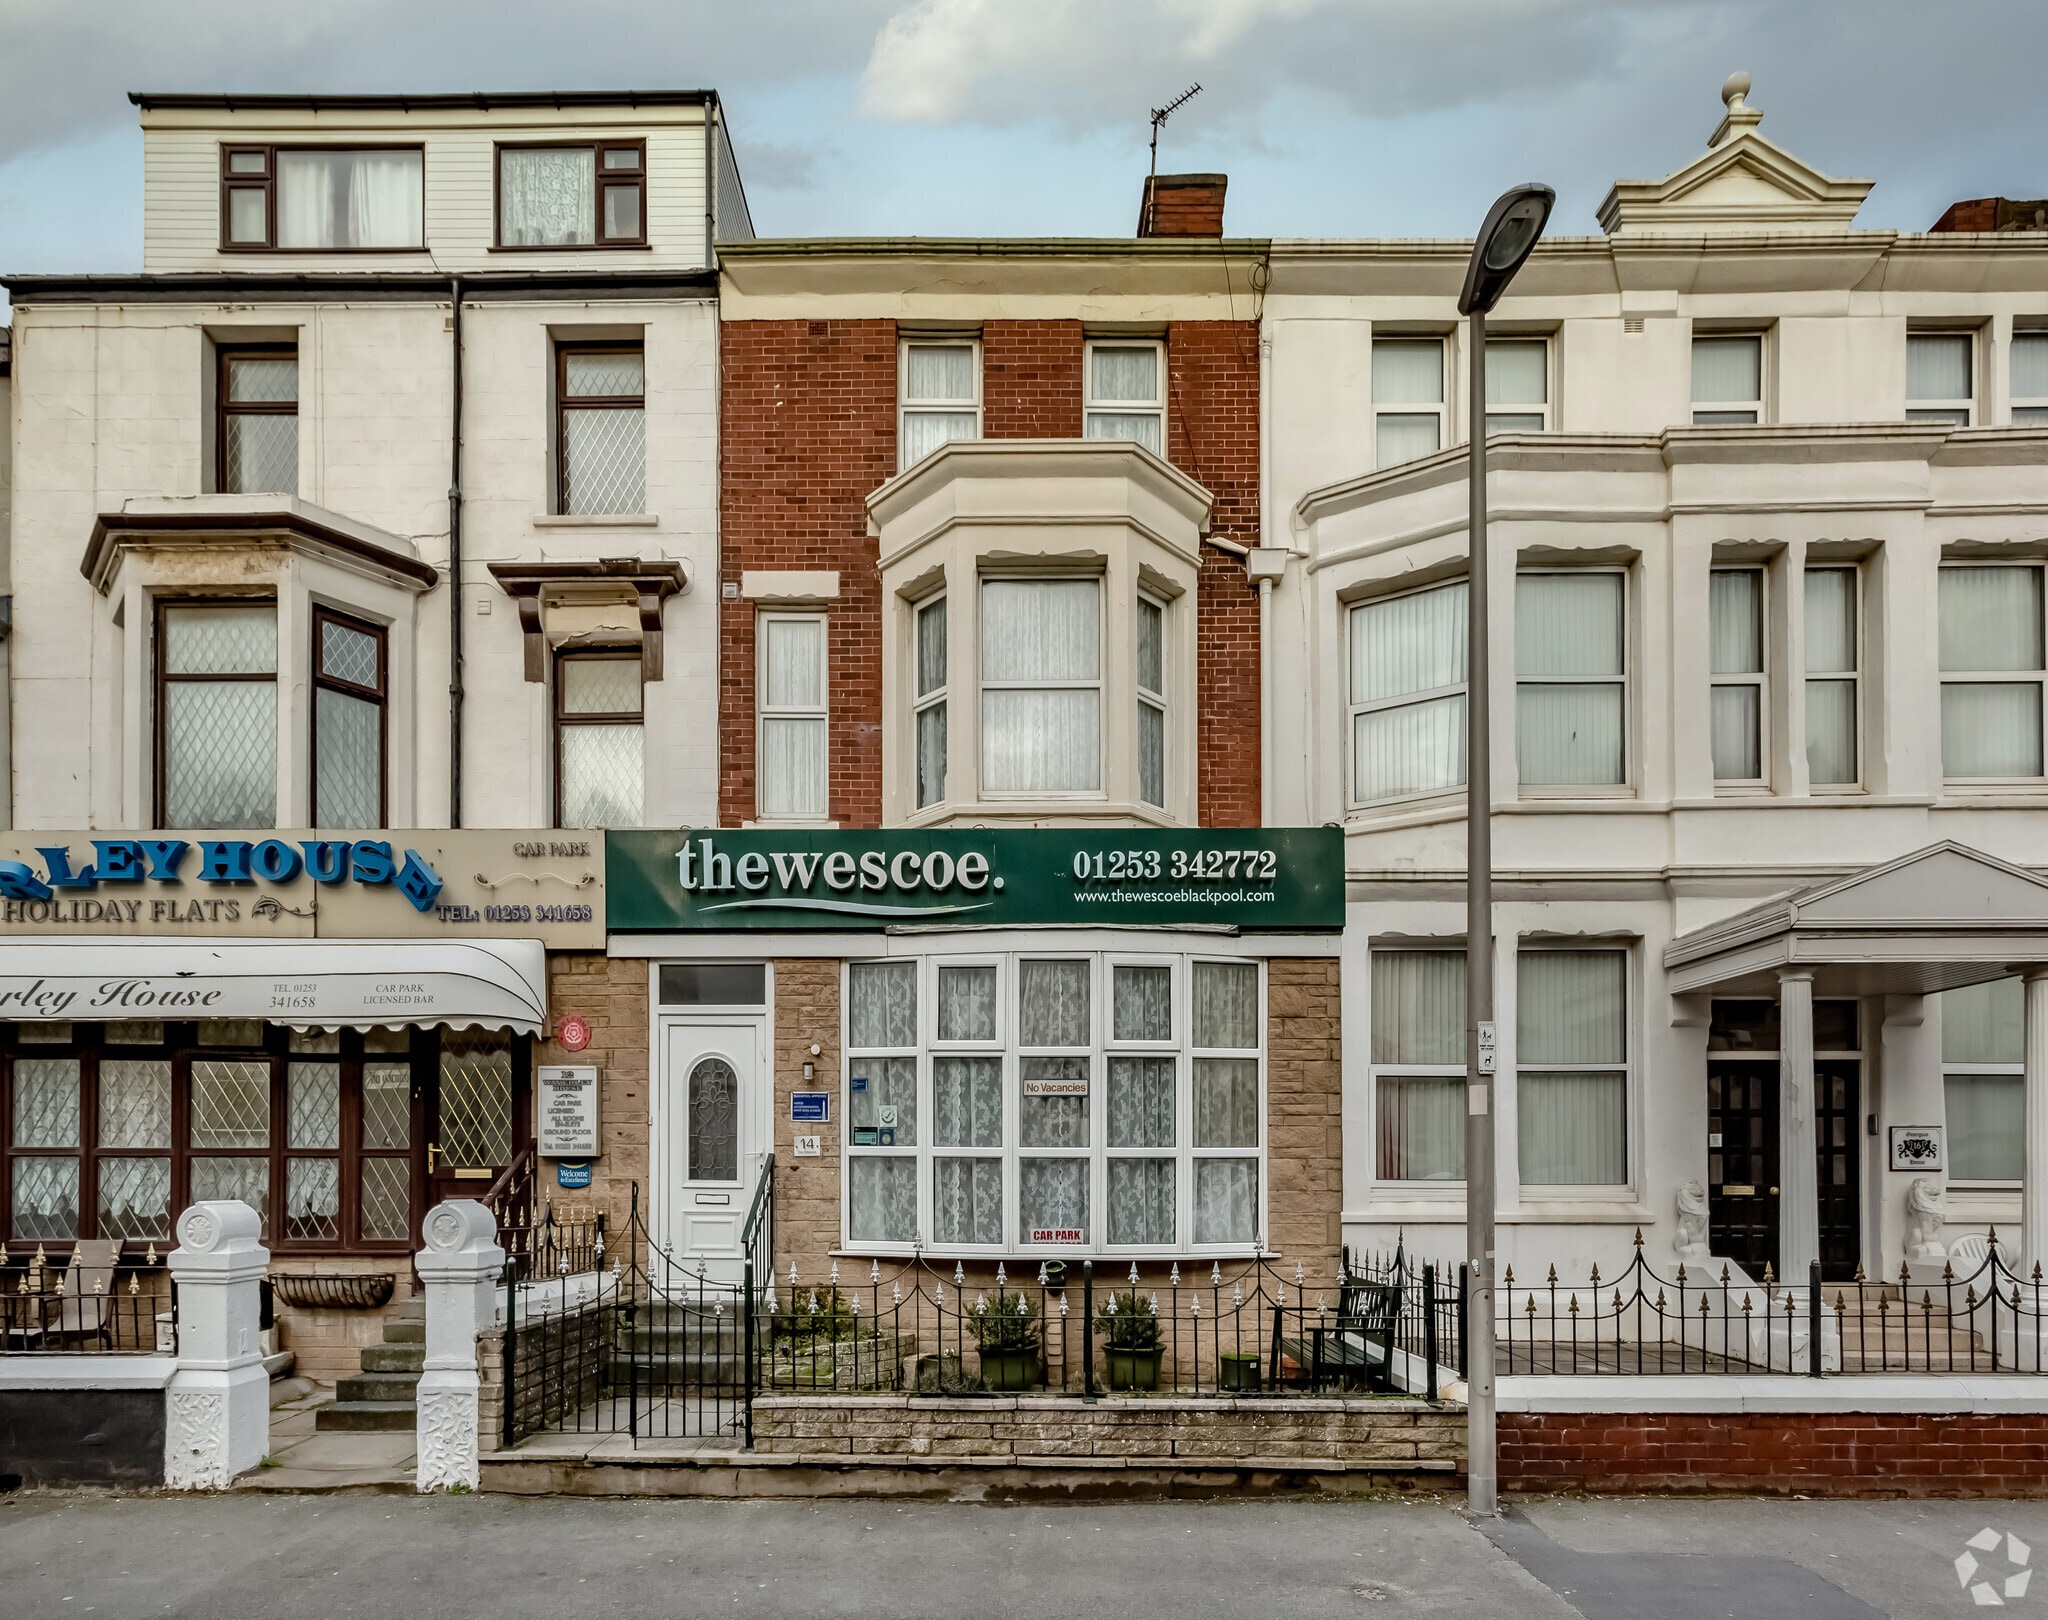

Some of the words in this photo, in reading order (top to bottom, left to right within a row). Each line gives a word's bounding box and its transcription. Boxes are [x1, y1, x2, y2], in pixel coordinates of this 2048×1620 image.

[512, 842, 546, 856] CAR
[549, 842, 590, 856] PARK
[675, 838, 1004, 890] thewescoe.
[1073, 850, 1161, 879] 01253
[1170, 850, 1277, 879] 342772
[197, 839, 443, 912] HOUSE
[1074, 888, 1275, 906] www.thewescoeblackpool.com
[1, 899, 142, 923] HOLIDAY
[149, 899, 240, 922] FLATS
[436, 905, 480, 922] TEL:
[483, 905, 531, 921] 01253
[535, 905, 592, 921] 341658
[90, 979, 224, 1007] House
[273, 984, 292, 993] TEL.
[293, 984, 317, 993] 01253
[376, 984, 396, 993] CAR
[398, 984, 424, 993] PARK
[269, 996, 316, 1008] 341658
[363, 995, 411, 1004] LICENSED
[413, 995, 434, 1004] BAR
[1026, 1083, 1039, 1092] No
[1041, 1082, 1086, 1092] Vacancies
[800, 1138, 814, 1149] 14
[560, 1169, 589, 1178] Welcome
[1033, 1230, 1053, 1241] CAR
[1055, 1230, 1081, 1240] PARK
